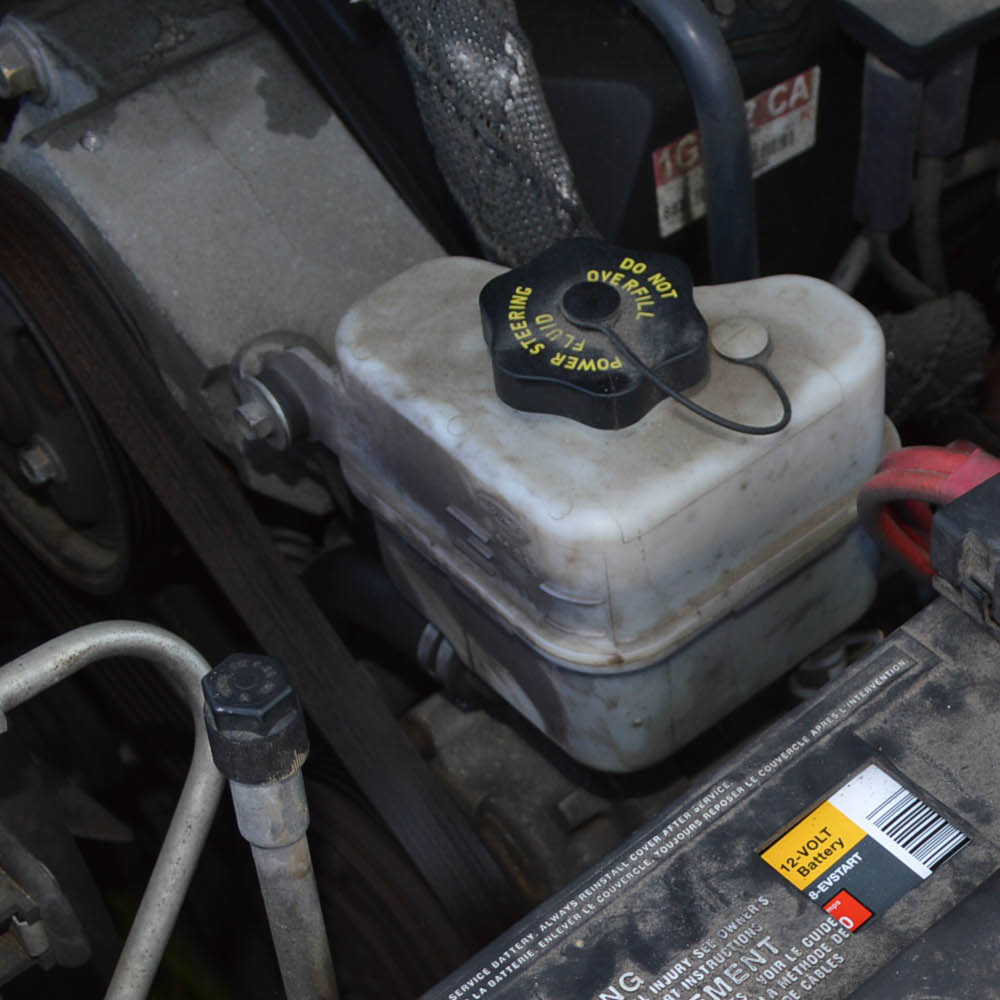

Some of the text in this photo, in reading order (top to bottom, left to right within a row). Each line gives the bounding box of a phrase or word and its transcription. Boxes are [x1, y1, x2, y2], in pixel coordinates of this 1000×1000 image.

[587, 270, 655, 321] OVERFILL
[620, 257, 679, 299] DO NOT
[508, 286, 623, 372] POWER STEERING
[535, 314, 588, 352] FLUID
[539, 899, 578, 932] ALWAYS
[577, 860, 630, 901] REINSTALL
[629, 834, 661, 861] COVER
[661, 810, 692, 836] AFTER
[778, 826, 833, 873] 12-VOLT
[795, 836, 846, 878] Battery
[679, 921, 763, 991] INSTRUCTIONS
[755, 958, 787, 985] VOIR
[800, 915, 838, 948] GUIDE
[829, 926, 850, 944] DE
[471, 986, 487, 1000] LA
[648, 957, 692, 994] INJURY
